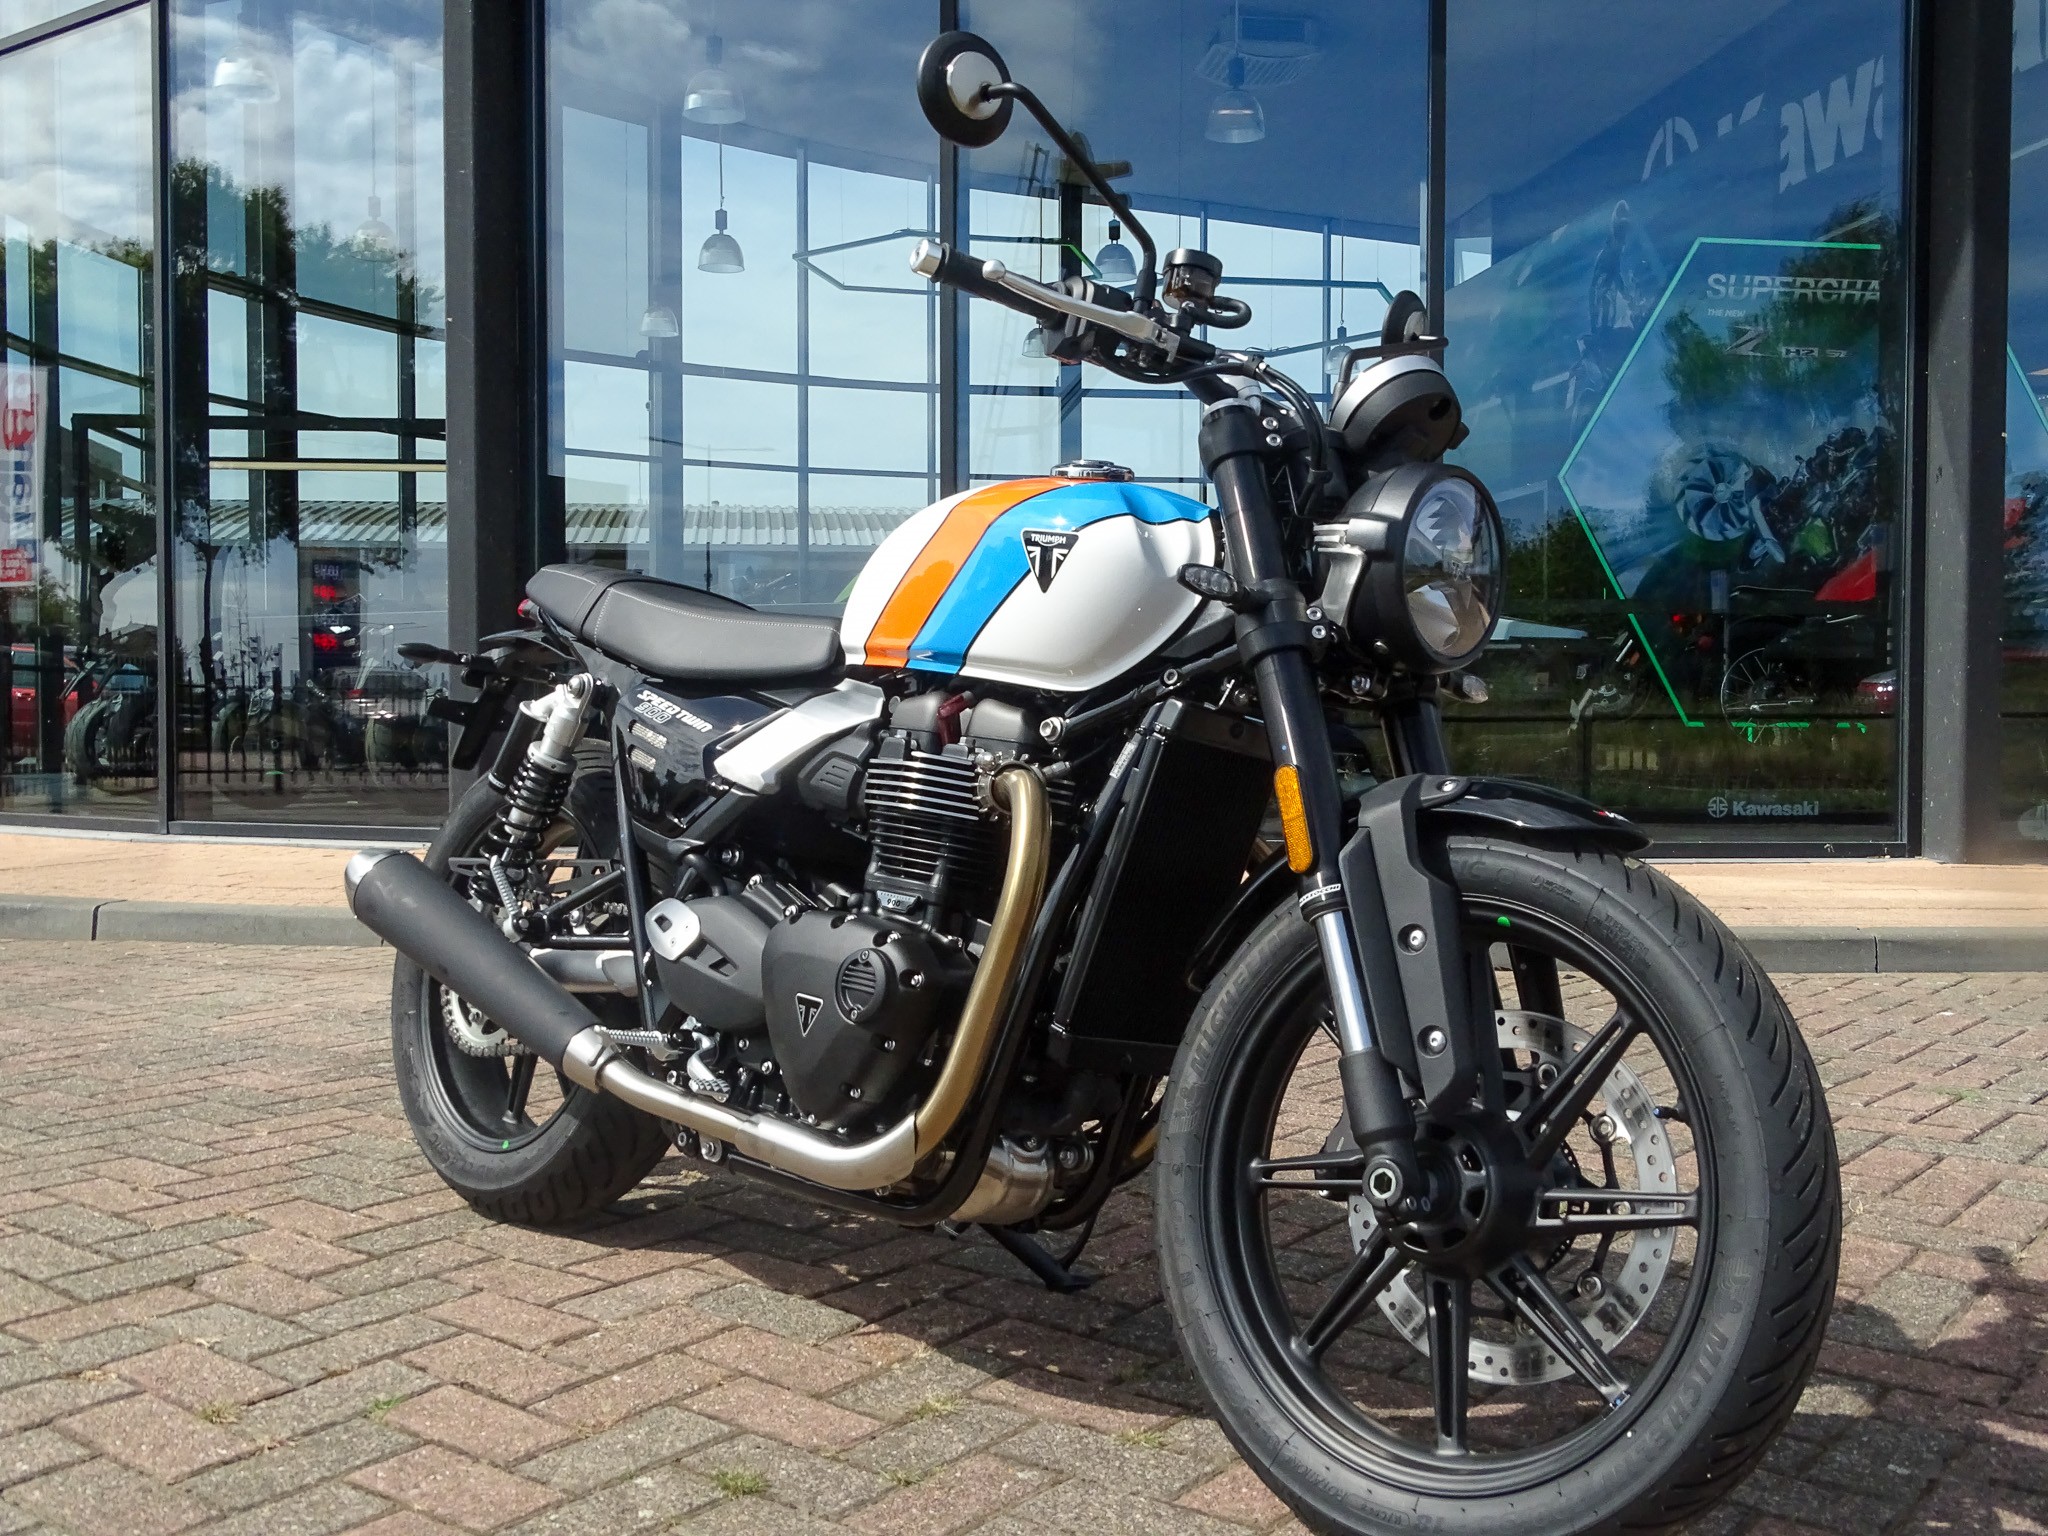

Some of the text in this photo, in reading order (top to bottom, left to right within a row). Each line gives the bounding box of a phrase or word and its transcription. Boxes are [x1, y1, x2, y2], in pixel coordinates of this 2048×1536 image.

[1726, 309, 1746, 318] NEW
[1031, 533, 1066, 545] TRIUMPH
[634, 701, 672, 724] 900
[637, 690, 713, 732] SPEED TWIN
[1732, 800, 1819, 816] Kawasaki
[886, 898, 901, 907] 900
